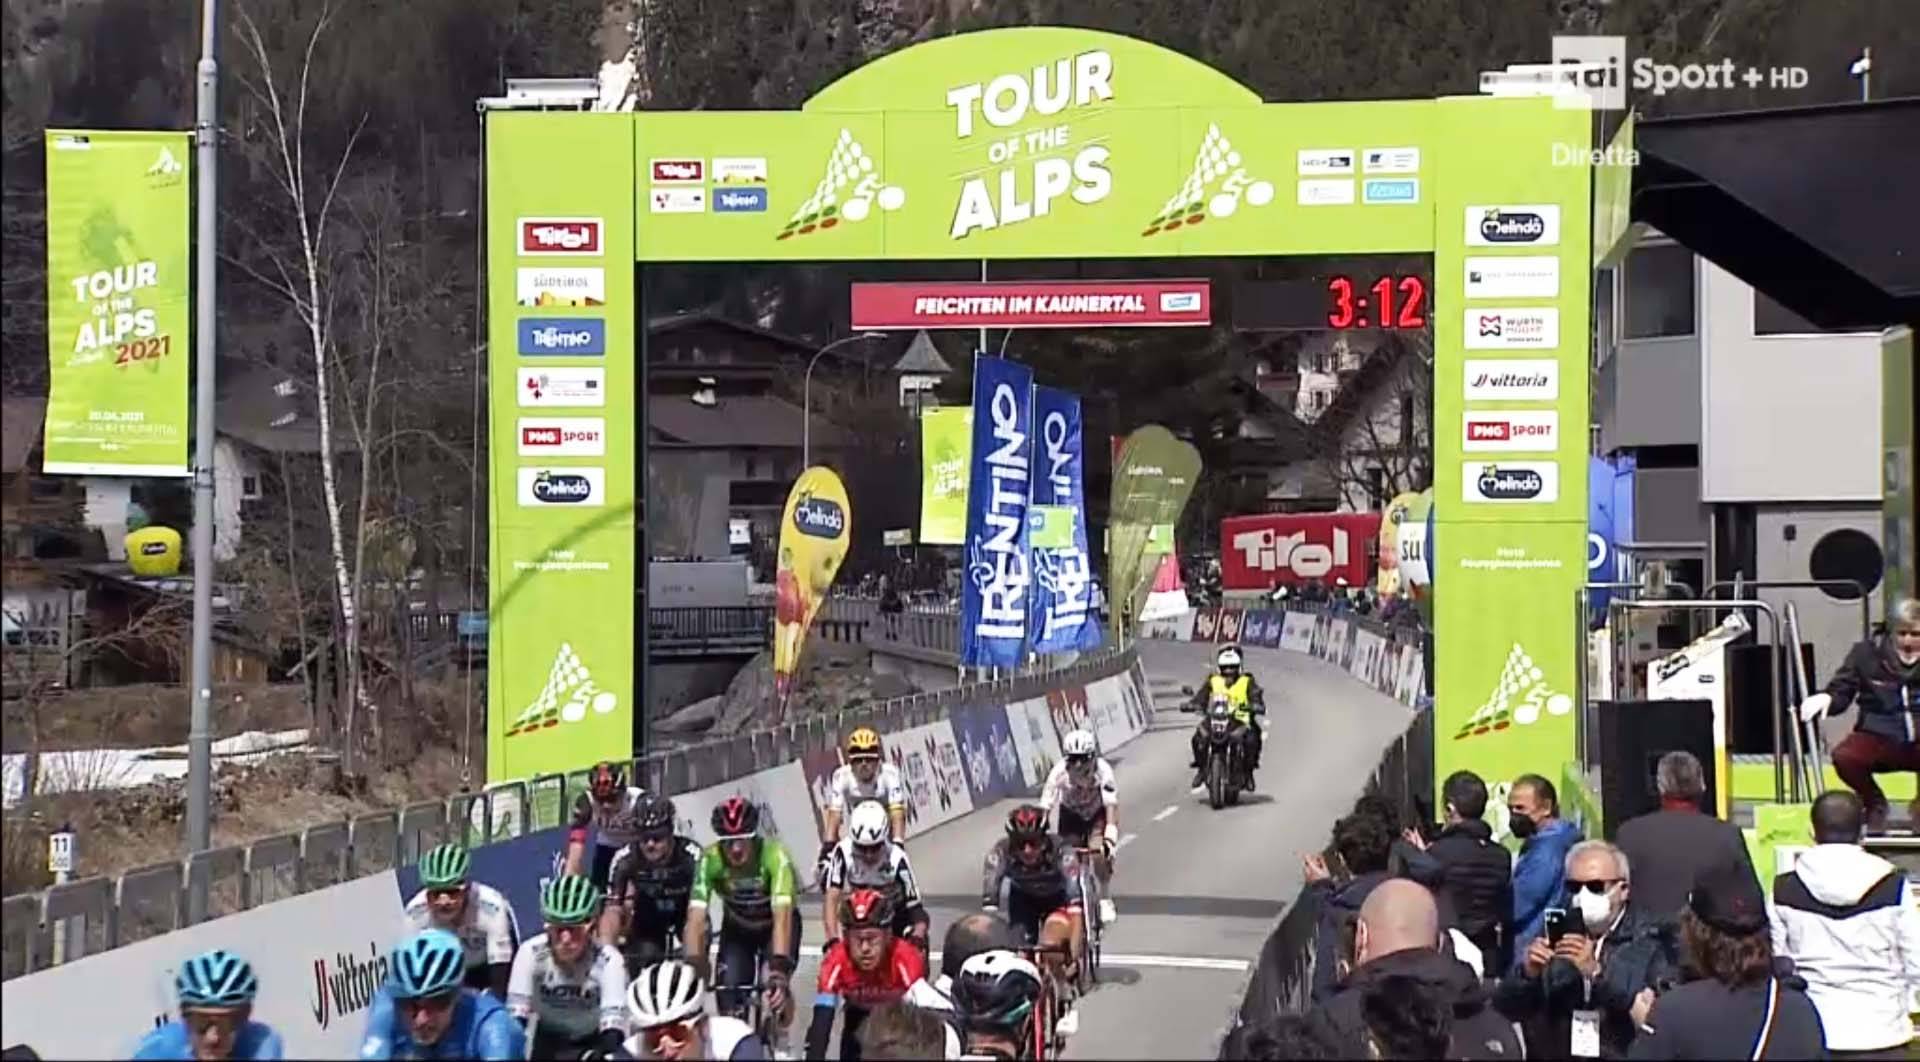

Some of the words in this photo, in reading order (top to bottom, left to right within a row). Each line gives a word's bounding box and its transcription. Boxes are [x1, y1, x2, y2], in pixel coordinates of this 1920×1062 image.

[946, 49, 1113, 138] TOUR
[989, 138, 1020, 163] OF
[1025, 124, 1070, 154] THE
[949, 145, 1113, 240] ALPS
[71, 261, 158, 303] TOUR
[915, 296, 1007, 314] FEICHTEN
[1009, 296, 1032, 313] IM
[1035, 294, 1145, 313] KAUNERTAL
[1329, 277, 1423, 328] 3:12
[75, 309, 156, 353] ALPS
[115, 335, 170, 364] 2021
[1490, 373, 1548, 387] vittoria
[563, 431, 599, 442] SPORT
[1473, 424, 1505, 438] PMG
[1512, 425, 1552, 436] SPORT
[1233, 527, 1348, 577] Tirol
[53, 837, 68, 852] 11
